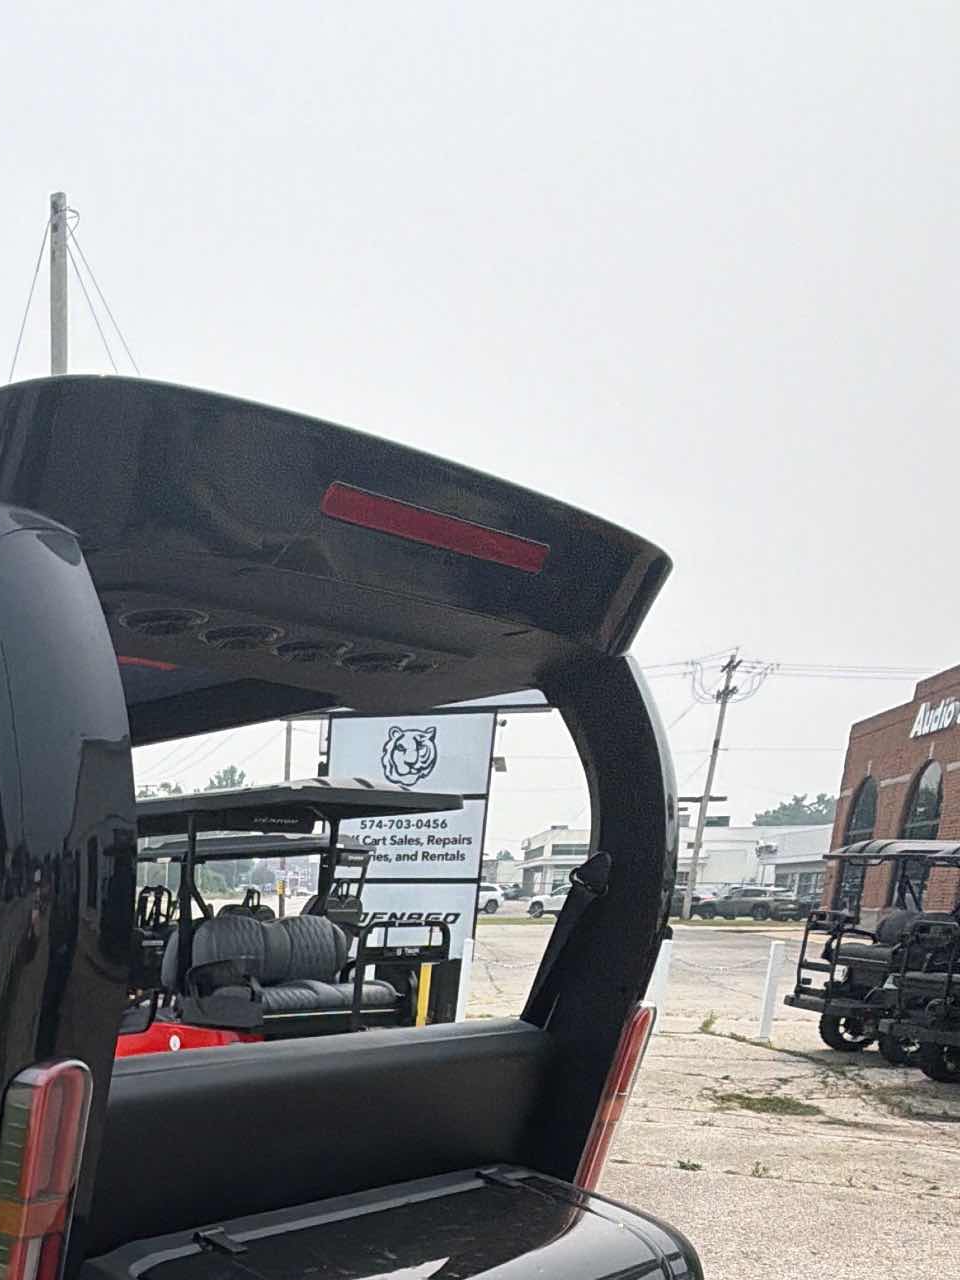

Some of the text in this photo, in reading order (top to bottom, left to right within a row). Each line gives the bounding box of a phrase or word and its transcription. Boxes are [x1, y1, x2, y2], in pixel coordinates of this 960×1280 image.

[909, 697, 955, 738] Audio
[360, 818, 448, 830] 574-703-0456
[362, 835, 388, 846] Cart
[390, 834, 425, 847] Sales,
[427, 833, 473, 848] Repairs
[395, 850, 418, 862] and
[421, 850, 466, 862] Rentals
